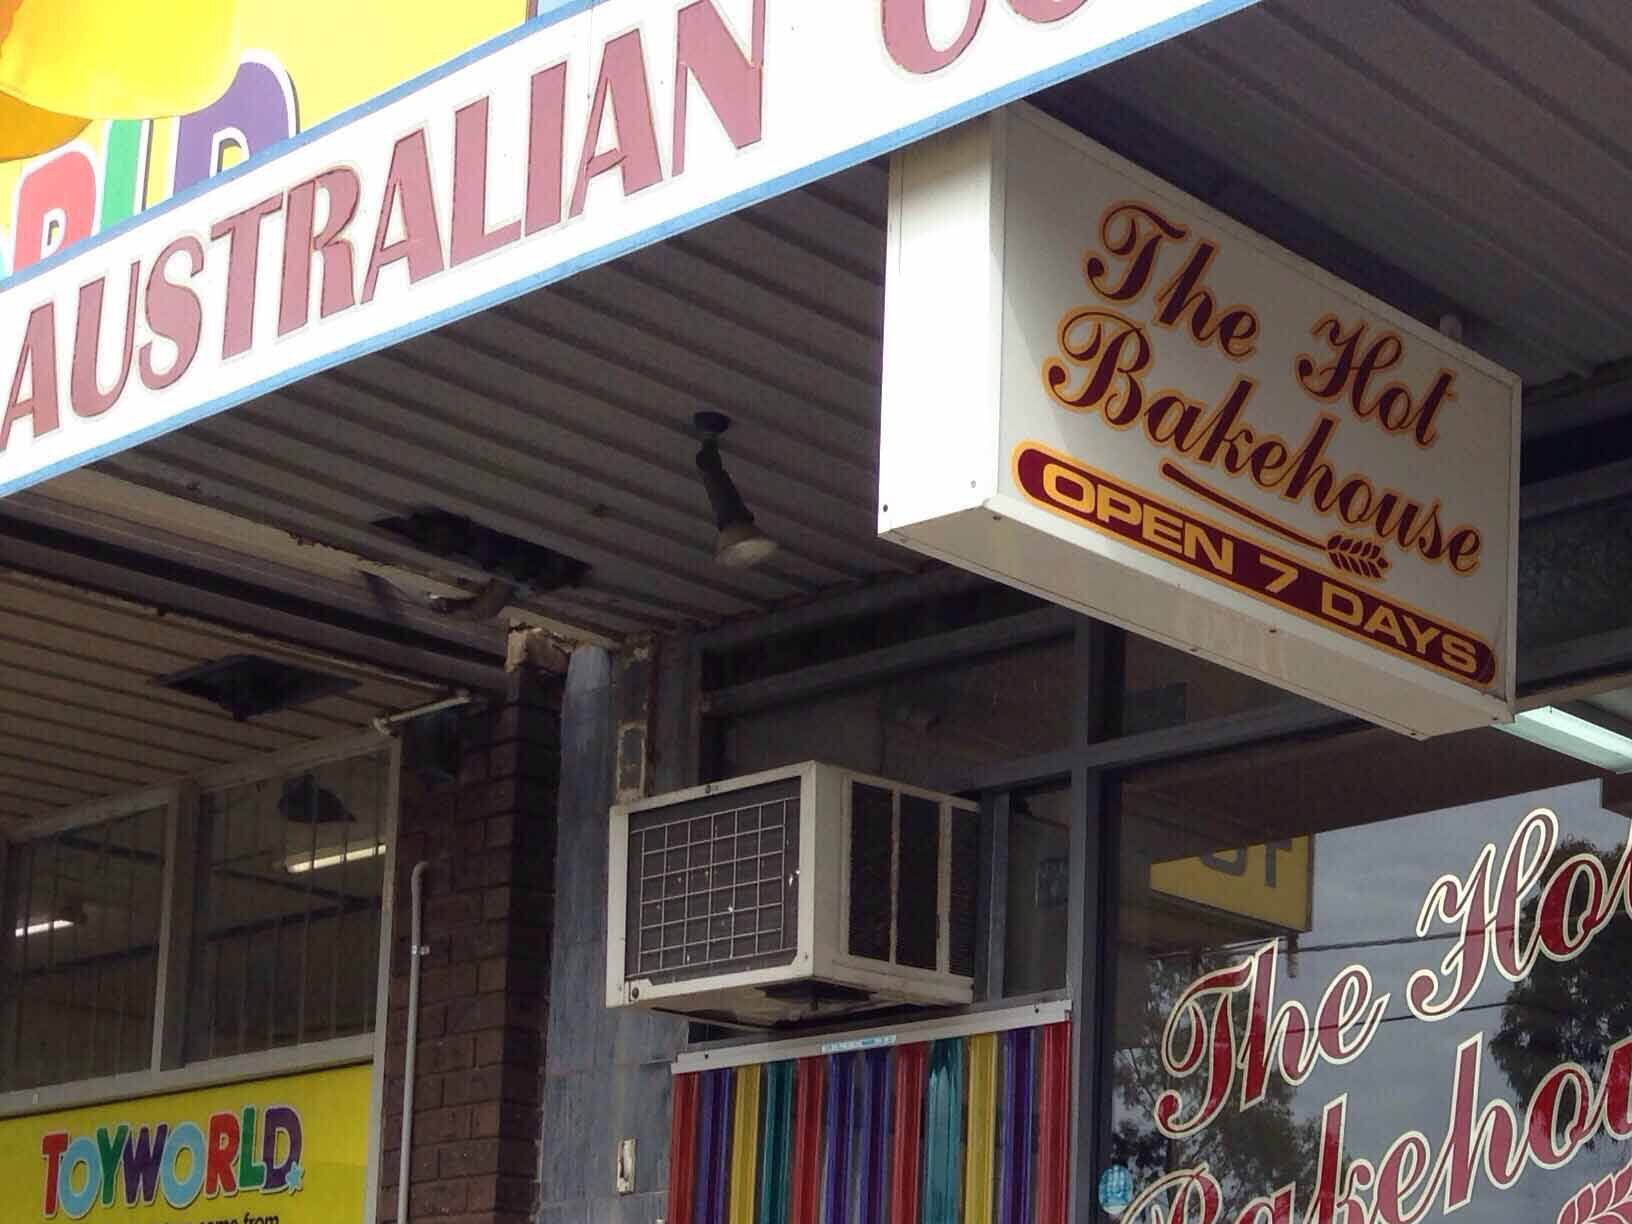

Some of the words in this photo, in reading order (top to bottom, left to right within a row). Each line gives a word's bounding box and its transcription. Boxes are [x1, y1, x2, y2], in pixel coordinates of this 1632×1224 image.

[0, 0, 766, 452] AUSTRALIAN
[1082, 202, 1260, 359] The
[1295, 312, 1457, 448] Hot
[1042, 310, 1484, 574] Bakehouse
[1042, 462, 1234, 576] OPEN
[1258, 555, 1300, 595] 7
[1320, 581, 1478, 675] DAYS
[1154, 937, 1391, 1139] The
[41, 1104, 303, 1219] TOYWORLD
